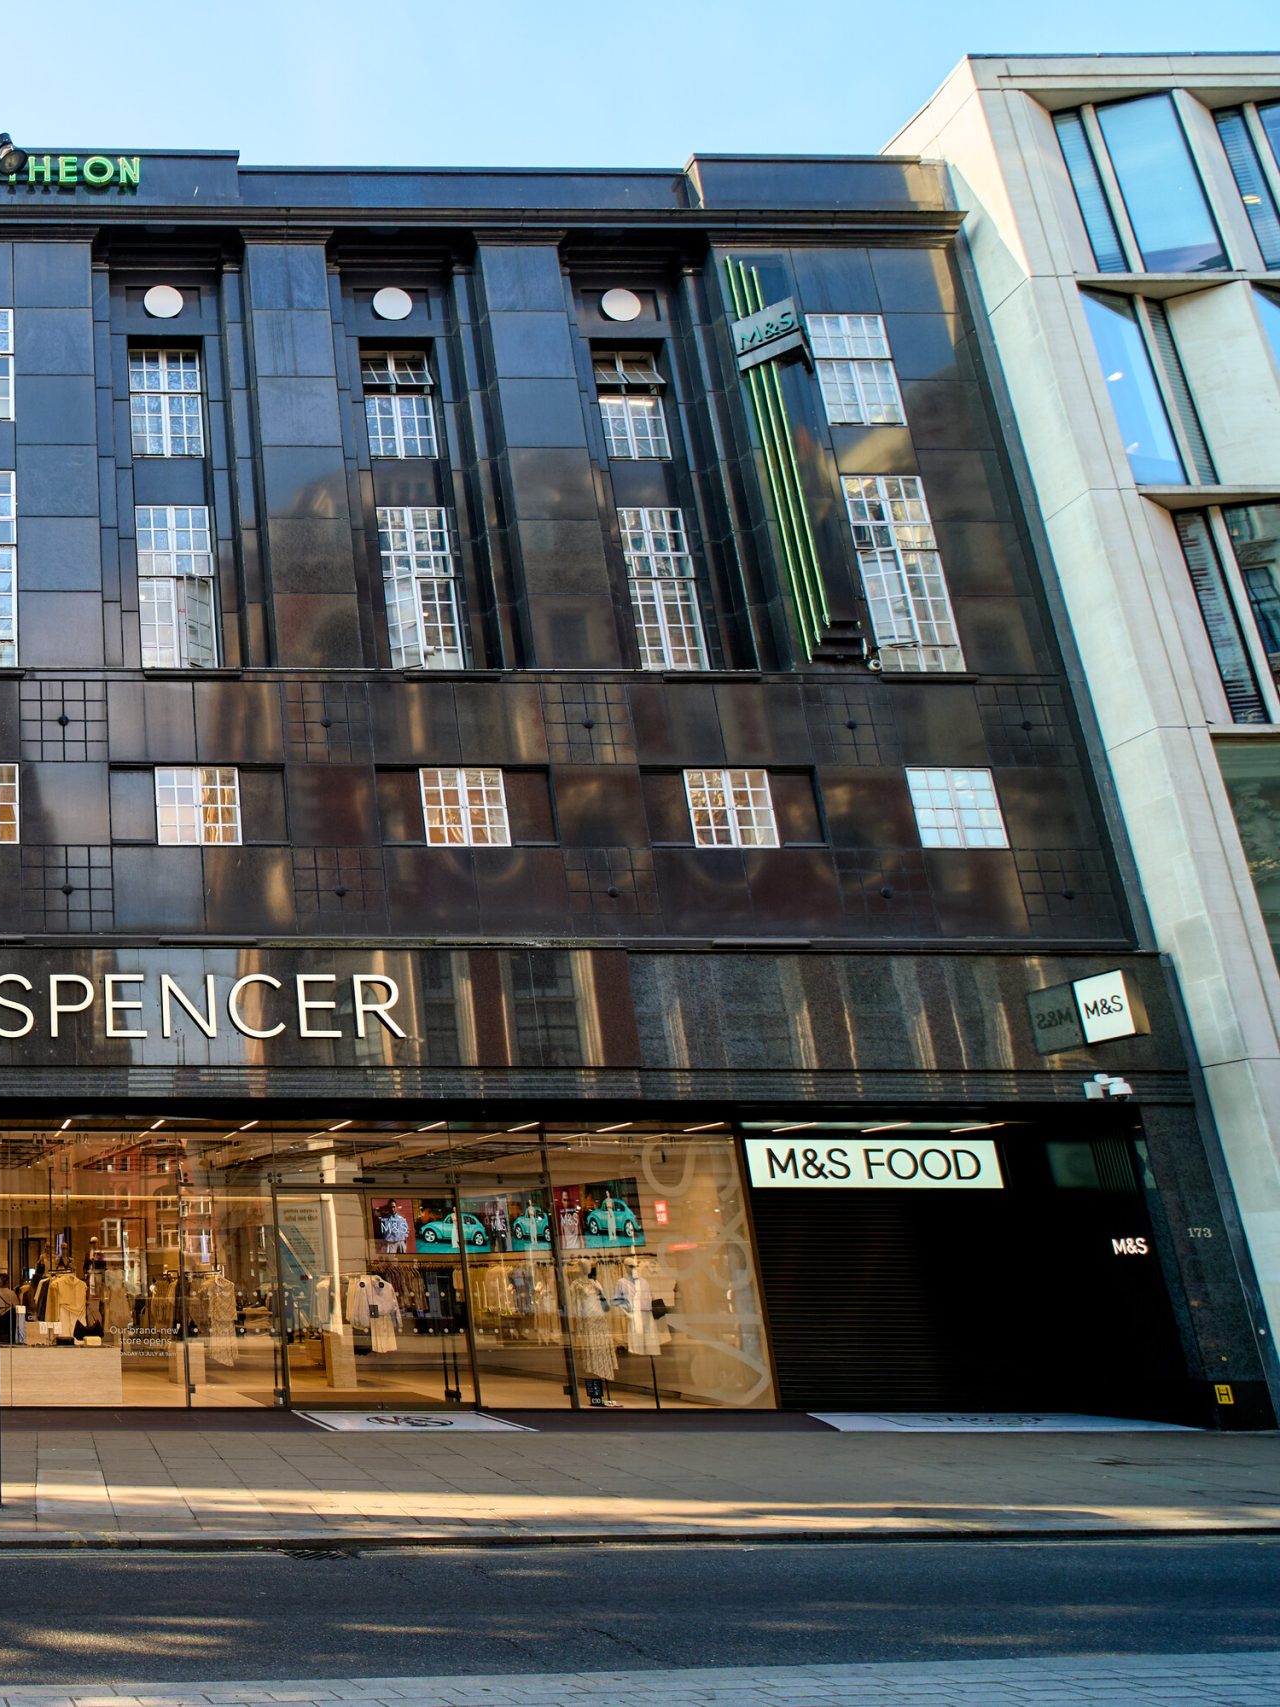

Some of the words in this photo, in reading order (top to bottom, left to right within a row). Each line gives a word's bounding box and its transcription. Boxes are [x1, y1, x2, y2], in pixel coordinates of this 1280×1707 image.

[740, 312, 793, 350] M&S
[1084, 995, 1123, 1019] M&S
[765, 1147, 851, 1180] M&S
[862, 1147, 983, 1181] FOOD
[380, 1220, 408, 1235] M&S
[1187, 1227, 1213, 1238] 173
[1111, 1237, 1148, 1255] M&S
[109, 1326, 128, 1335] Our
[129, 1326, 179, 1335] brand-new
[143, 1338, 171, 1347] opens
